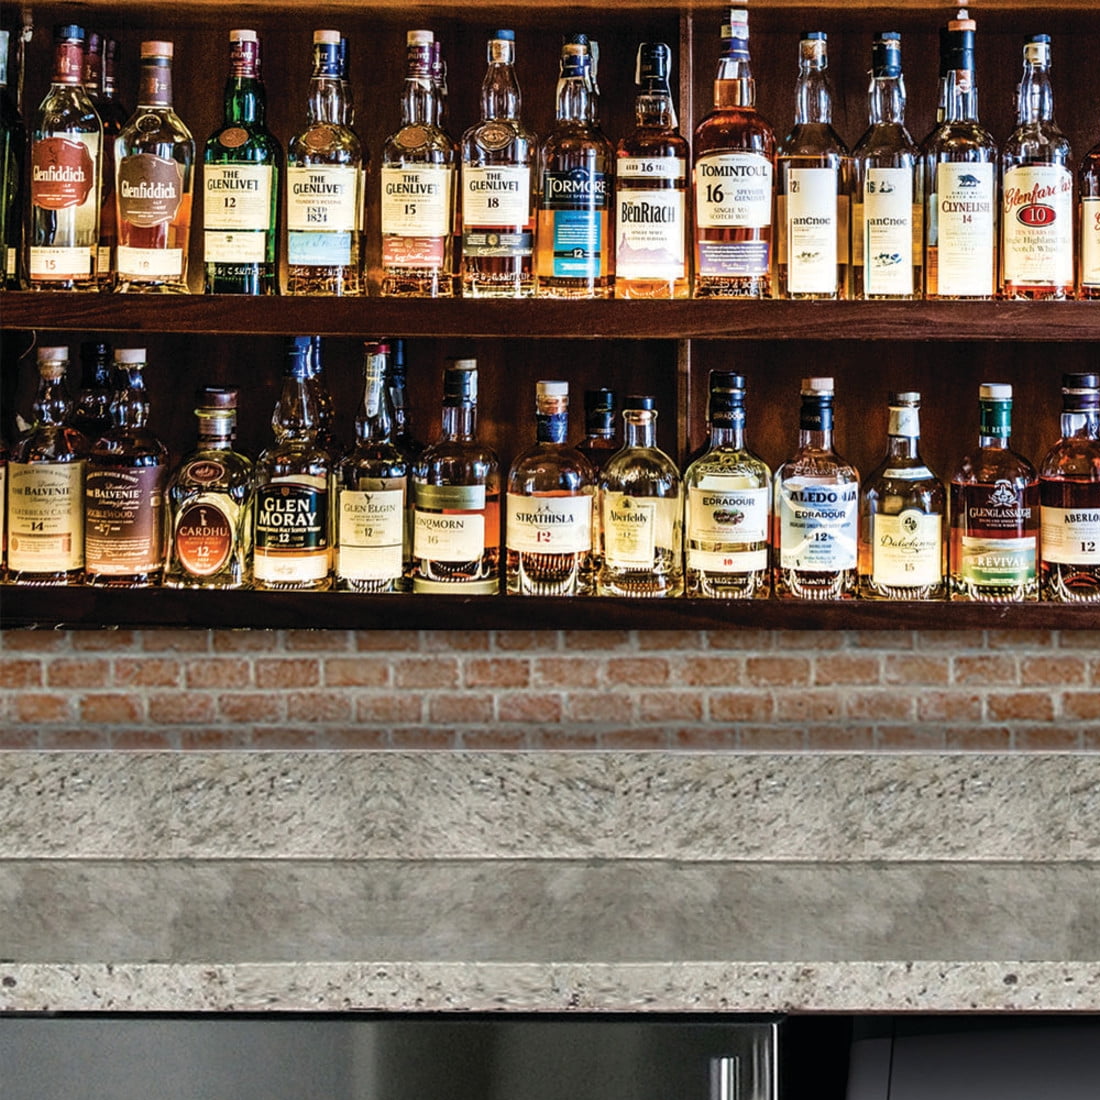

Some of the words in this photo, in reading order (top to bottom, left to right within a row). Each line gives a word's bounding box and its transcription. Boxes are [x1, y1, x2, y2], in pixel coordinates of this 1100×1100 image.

[641, 163, 653, 172] 16
[700, 163, 768, 177] TOMINTOUL
[33, 165, 85, 182] Glenfiddich
[222, 170, 239, 179] THE
[309, 175, 325, 183] THE
[402, 174, 420, 183] THE
[486, 172, 501, 181] THE
[121, 180, 176, 198] Glenfiddich
[207, 179, 258, 191] GLENLIVET
[293, 183, 343, 194] GLENLIVET
[386, 183, 438, 195] GLENLIVET
[469, 180, 519, 192] GLENLIVET
[547, 177, 606, 198] TORMORE
[867, 181, 876, 193] 16
[706, 184, 724, 203] 16
[224, 197, 236, 208] 12
[487, 198, 499, 208] 18
[942, 200, 990, 213] CLYNELISH
[404, 204, 416, 215] 15
[1030, 208, 1046, 222] 10
[307, 213, 328, 222] 1824
[793, 217, 831, 225] anCnoc
[870, 217, 908, 226] anCnoc
[962, 215, 972, 223] 14
[573, 249, 583, 258] 12
[45, 260, 56, 270] 15
[24, 486, 70, 497] BALVENIE
[94, 488, 140, 499] BALVENIE
[264, 498, 310, 513] GLEN
[703, 497, 755, 506] EDRADOUR
[344, 503, 366, 513] GLEN
[368, 503, 396, 513] ELGIN
[969, 507, 1031, 518] GLENGLASSAUGH
[259, 511, 318, 526] MORAY
[516, 512, 574, 524] STRATHISLA
[609, 510, 648, 523] Aberfeldy
[795, 510, 846, 519] EDRADOUR
[31, 522, 44, 531] 14
[180, 526, 229, 537] CARDHU
[279, 533, 289, 542] 12
[364, 528, 373, 537] 12
[536, 531, 551, 542] 12
[815, 532, 828, 541] 12
[197, 547, 209, 557] 12
[1080, 541, 1096, 552] 12
[978, 556, 1026, 567] REVIVAL
